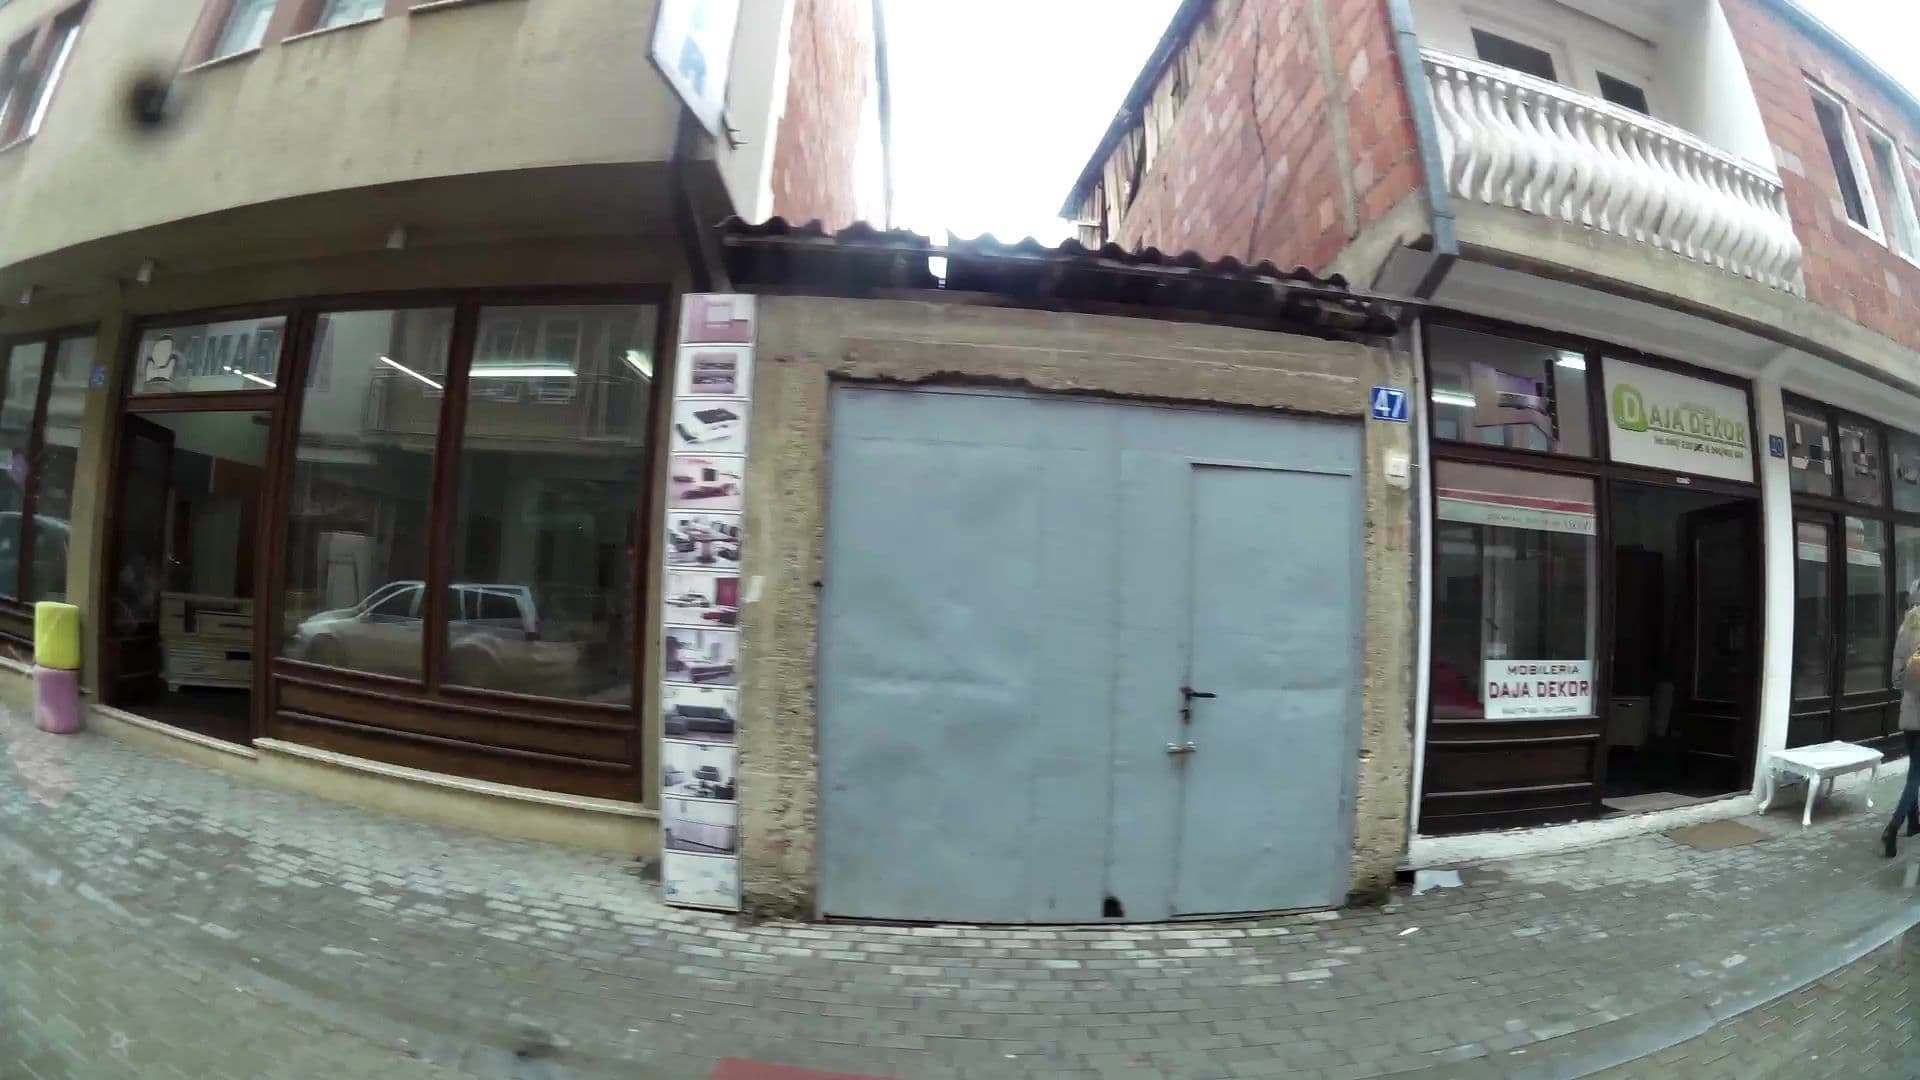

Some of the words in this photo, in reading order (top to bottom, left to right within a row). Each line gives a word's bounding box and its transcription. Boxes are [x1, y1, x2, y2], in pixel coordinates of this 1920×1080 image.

[1375, 389, 1405, 418] 47
[1689, 411, 1745, 443] DEKOR
[1507, 664, 1580, 676] MOBILERIA
[1488, 681, 1531, 699] DAJA
[1536, 680, 1590, 698] DEKOR
